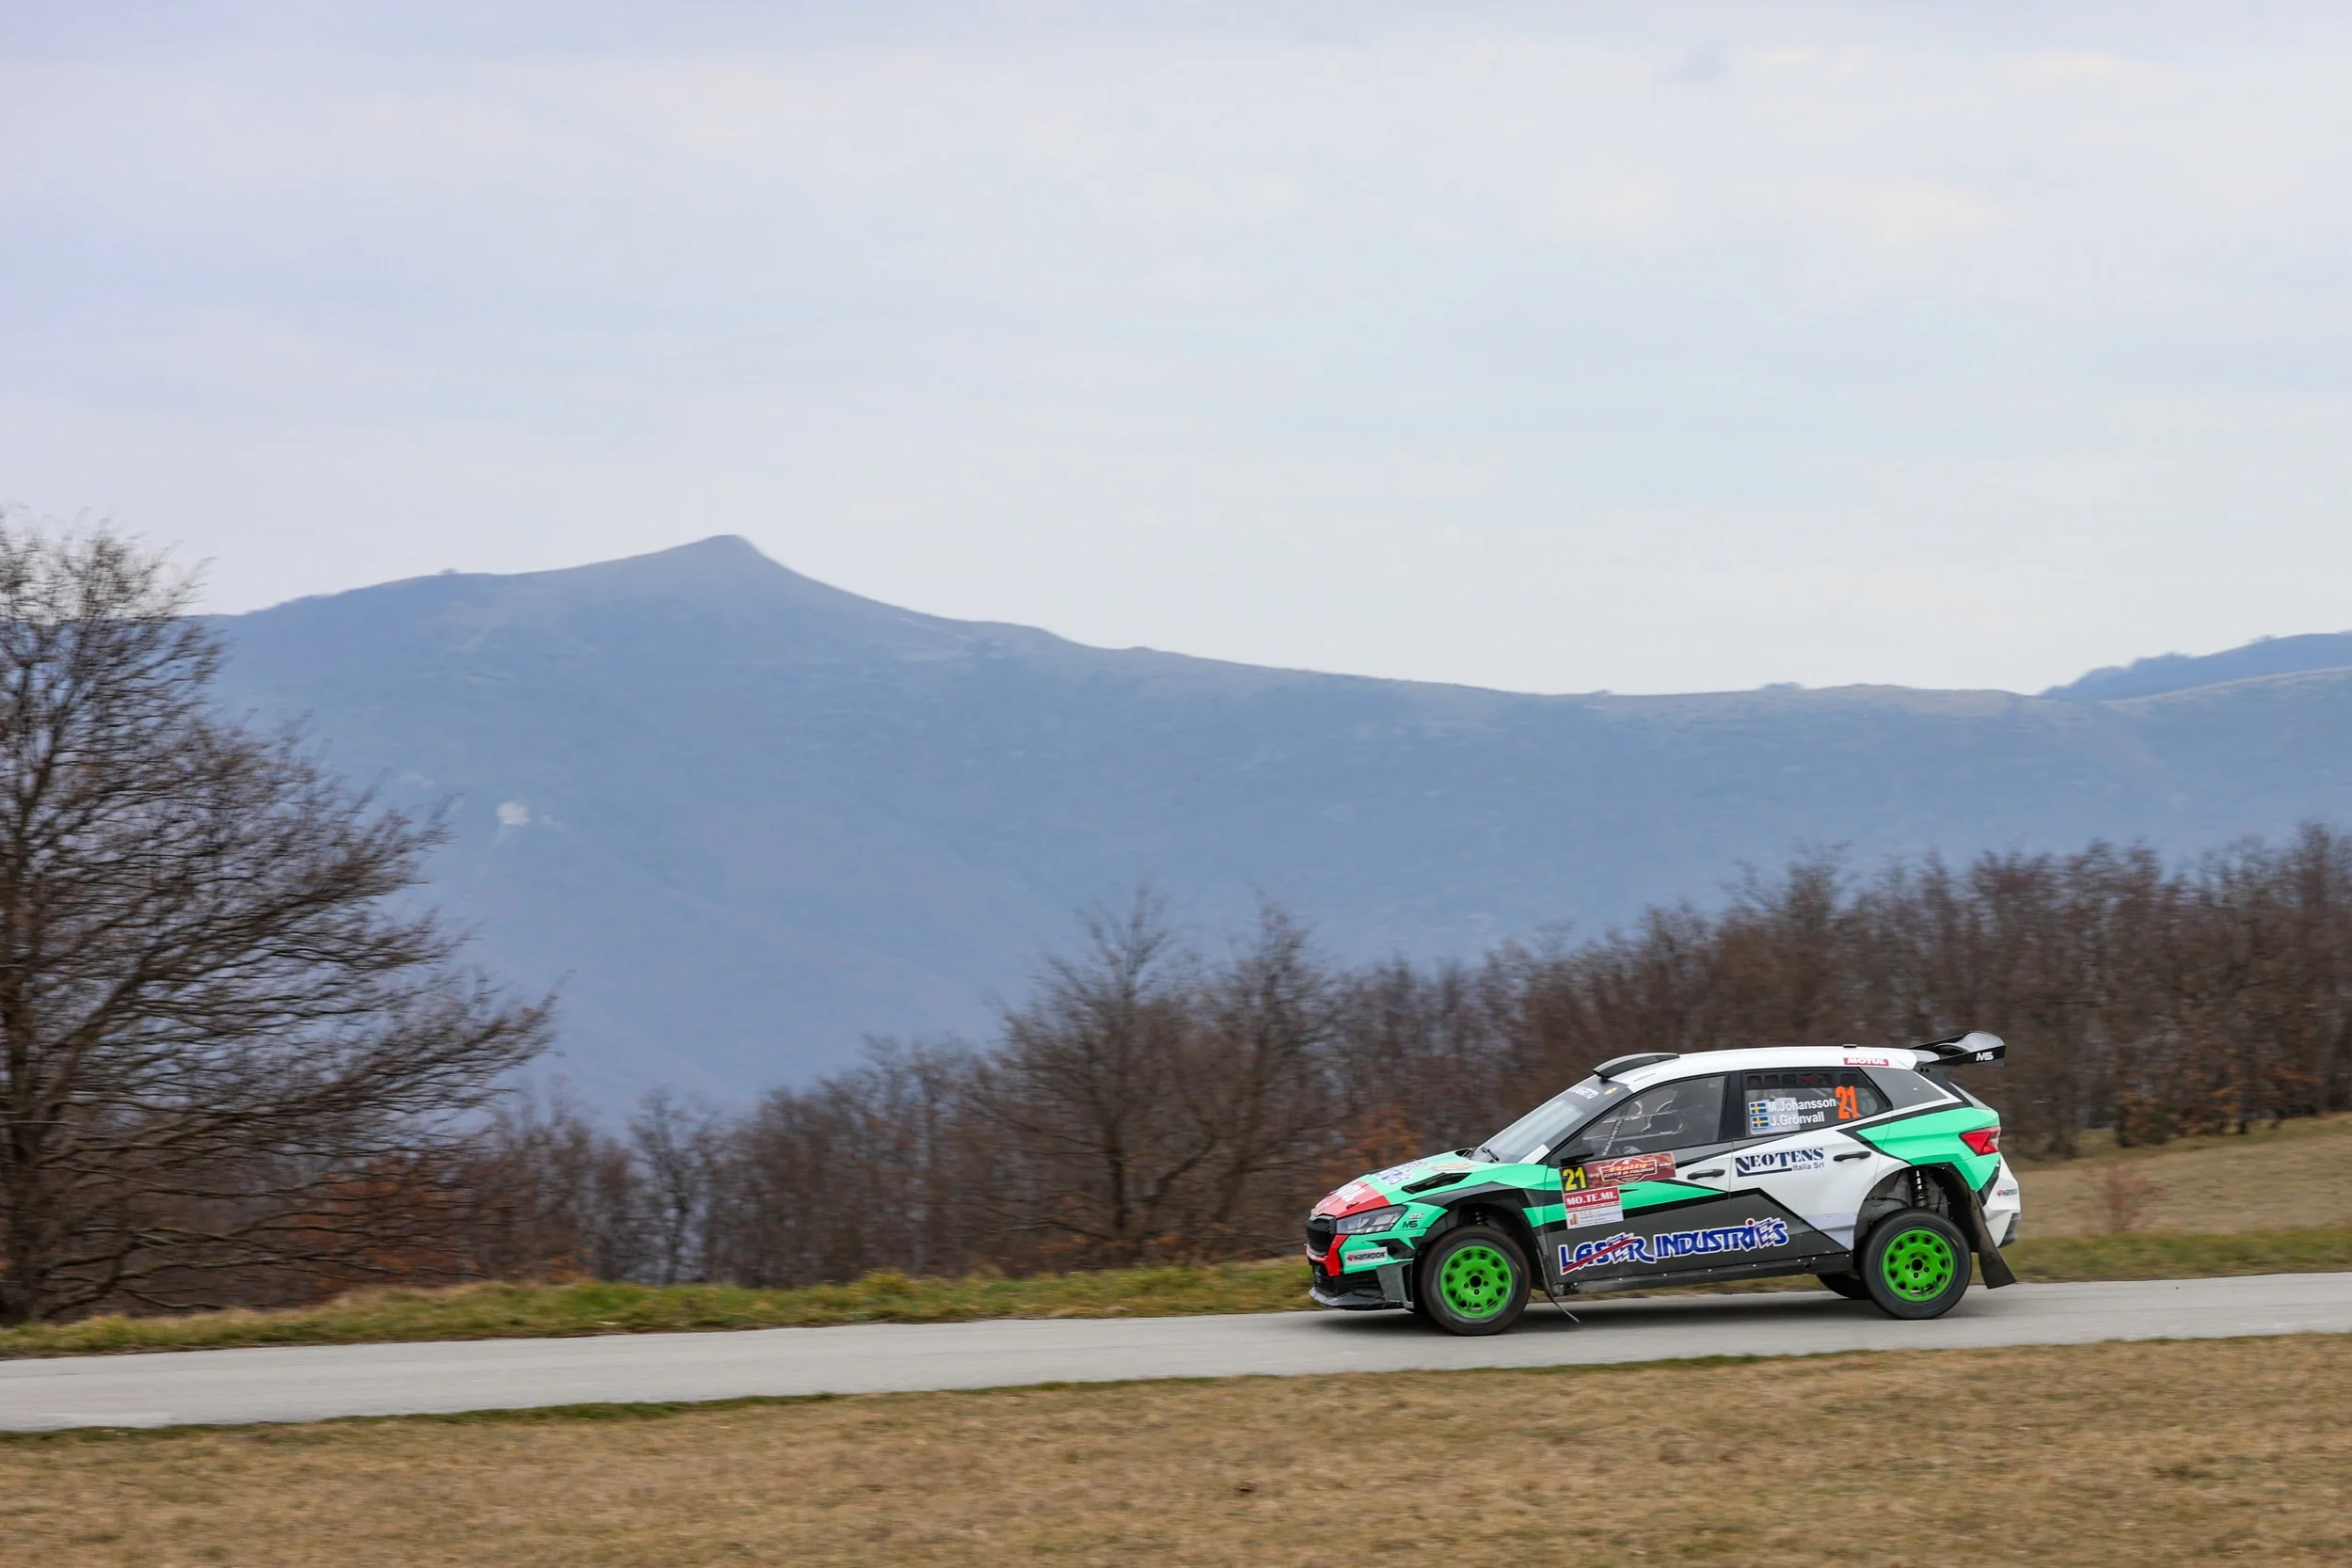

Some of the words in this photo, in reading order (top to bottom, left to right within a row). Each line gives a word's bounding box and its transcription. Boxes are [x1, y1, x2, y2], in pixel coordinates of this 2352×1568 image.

[1768, 1098, 1836, 1113] M.Johansson
[1836, 1085, 1860, 1119] 21
[1735, 1148, 1825, 1174] NEOTENS
[1792, 1163, 1812, 1171] Italia
[1563, 1166, 1587, 1192] 21
[1565, 1191, 1617, 1205] MO.TE.MI.
[1558, 1232, 1657, 1275] LASER
